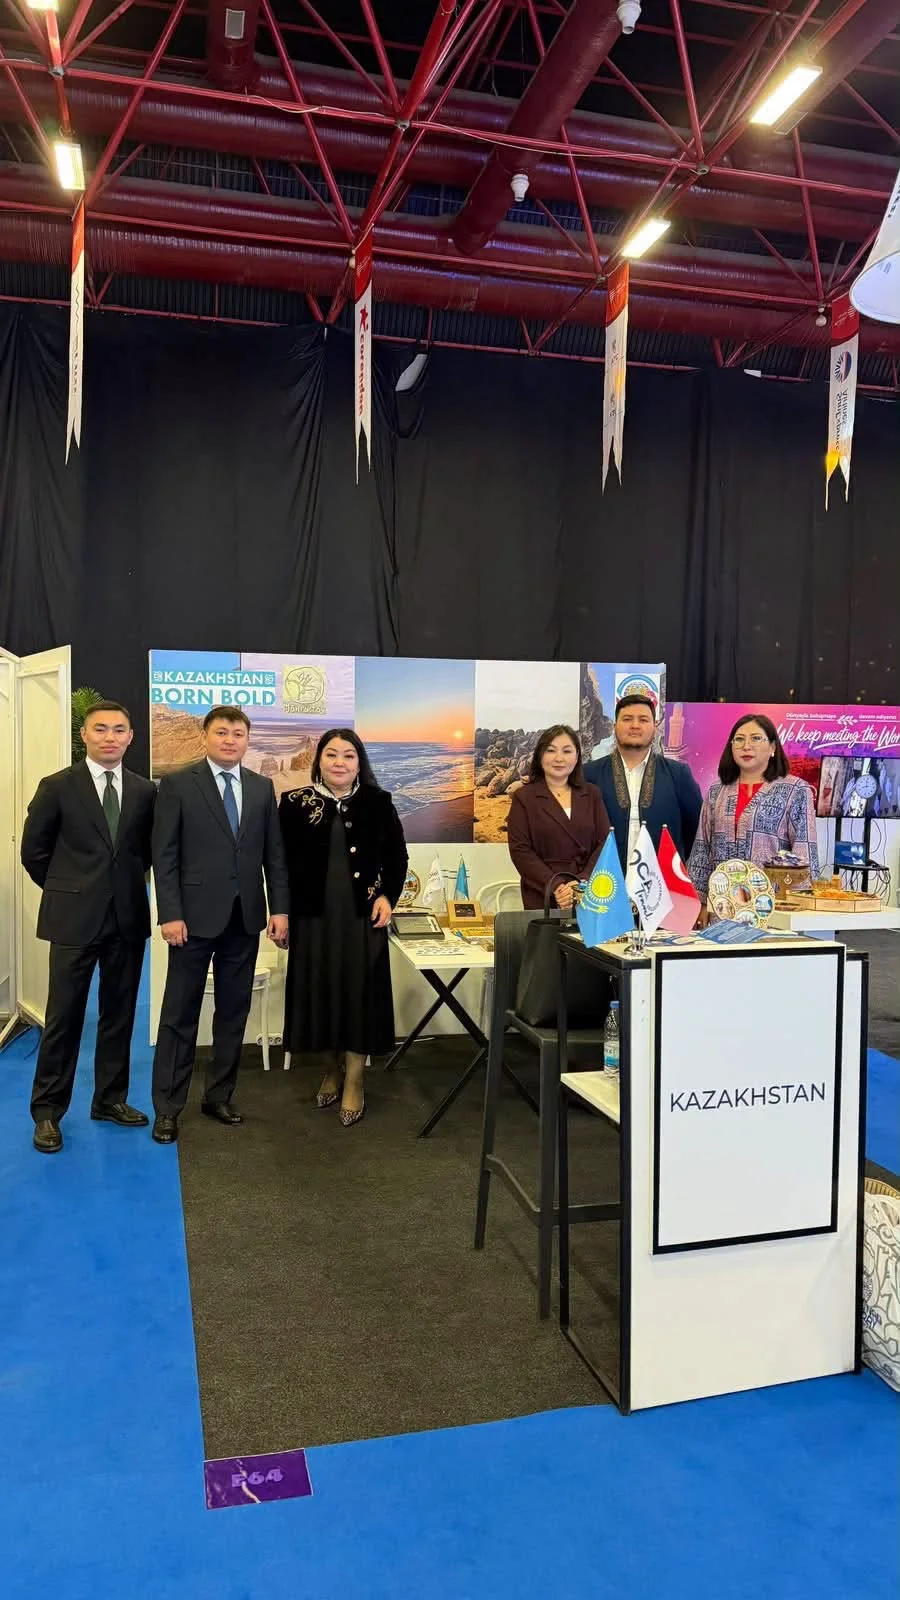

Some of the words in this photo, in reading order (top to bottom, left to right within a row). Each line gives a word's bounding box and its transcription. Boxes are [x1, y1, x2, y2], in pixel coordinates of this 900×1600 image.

[358, 334, 366, 417] corendon
[164, 671, 264, 685] KAZAKHSTAN
[151, 687, 213, 704] BORN
[221, 689, 276, 706] BOLD
[777, 721, 795, 745] We
[795, 723, 821, 748] keep
[822, 726, 860, 748] meeting
[860, 724, 878, 741] the
[670, 1082, 826, 1113] KAZAKHSTAN
